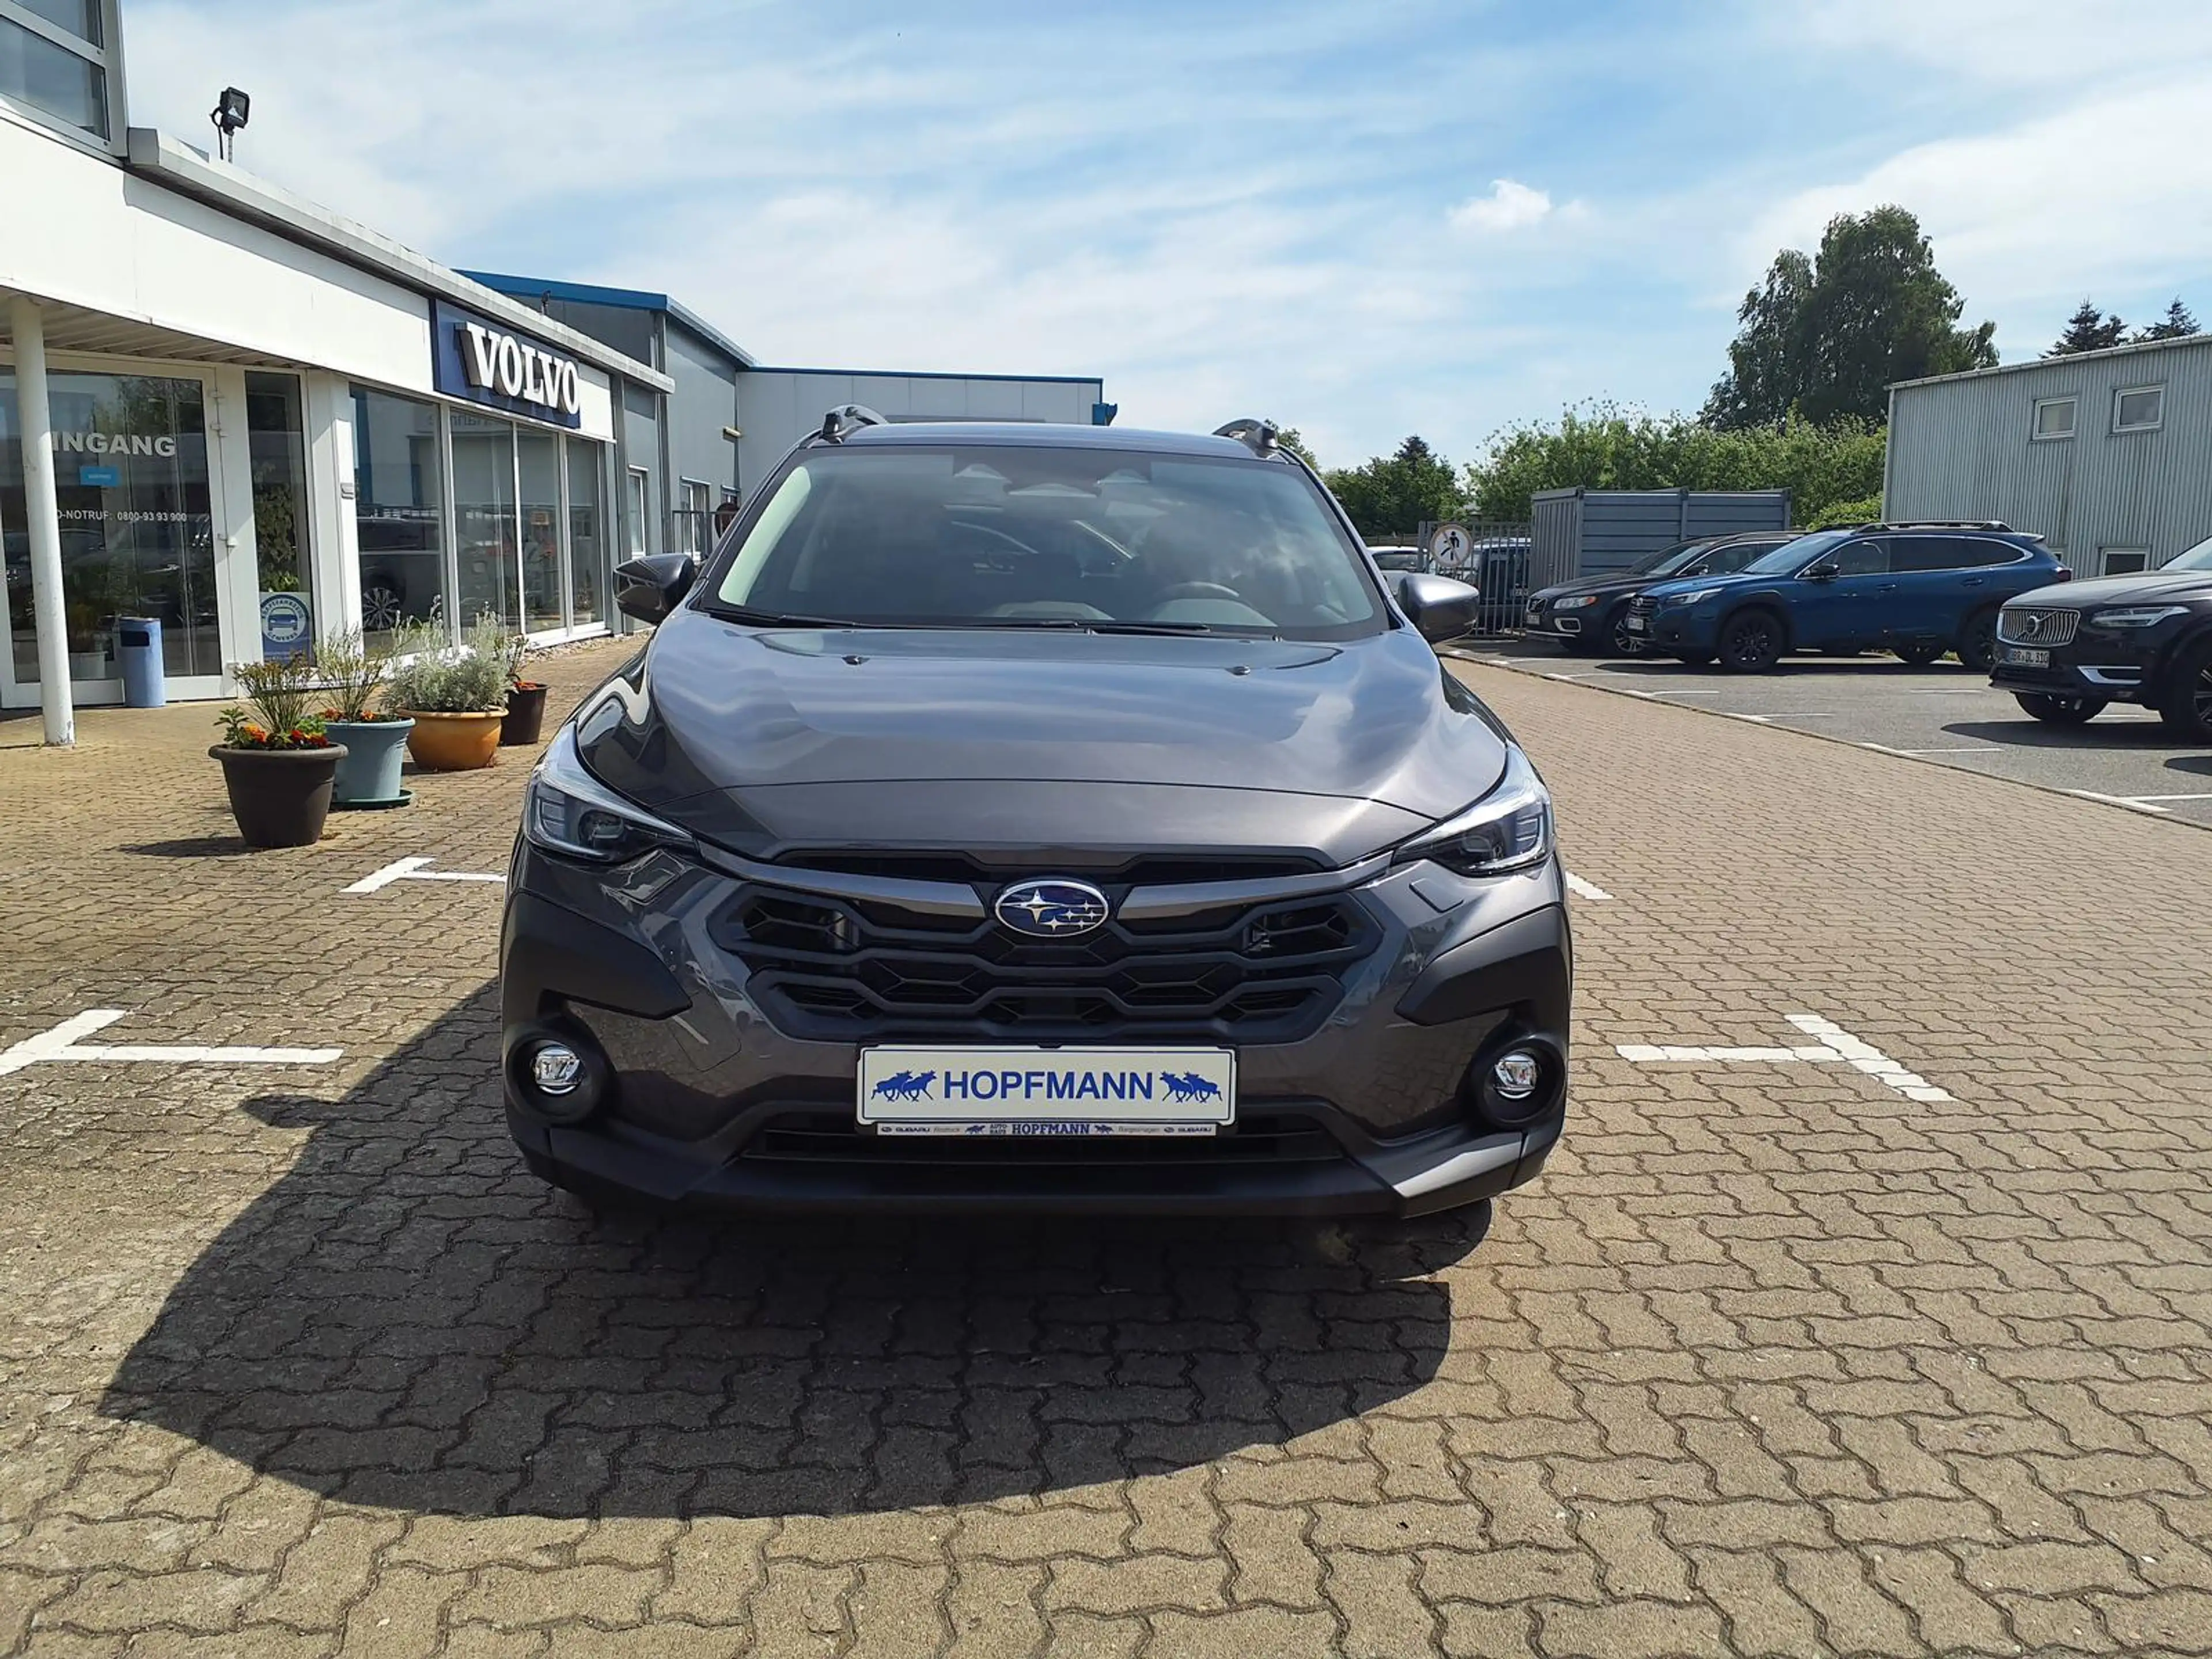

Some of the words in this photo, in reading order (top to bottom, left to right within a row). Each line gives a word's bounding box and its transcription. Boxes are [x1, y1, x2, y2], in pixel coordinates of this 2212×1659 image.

[467, 321, 580, 414] VOLVO
[51, 432, 176, 457] INGANG
[117, 510, 154, 521] 0800-93
[156, 512, 168, 521] 93
[944, 1071, 1152, 1100] HOPFMANN
[1012, 1124, 1090, 1135] HOPFMANN
